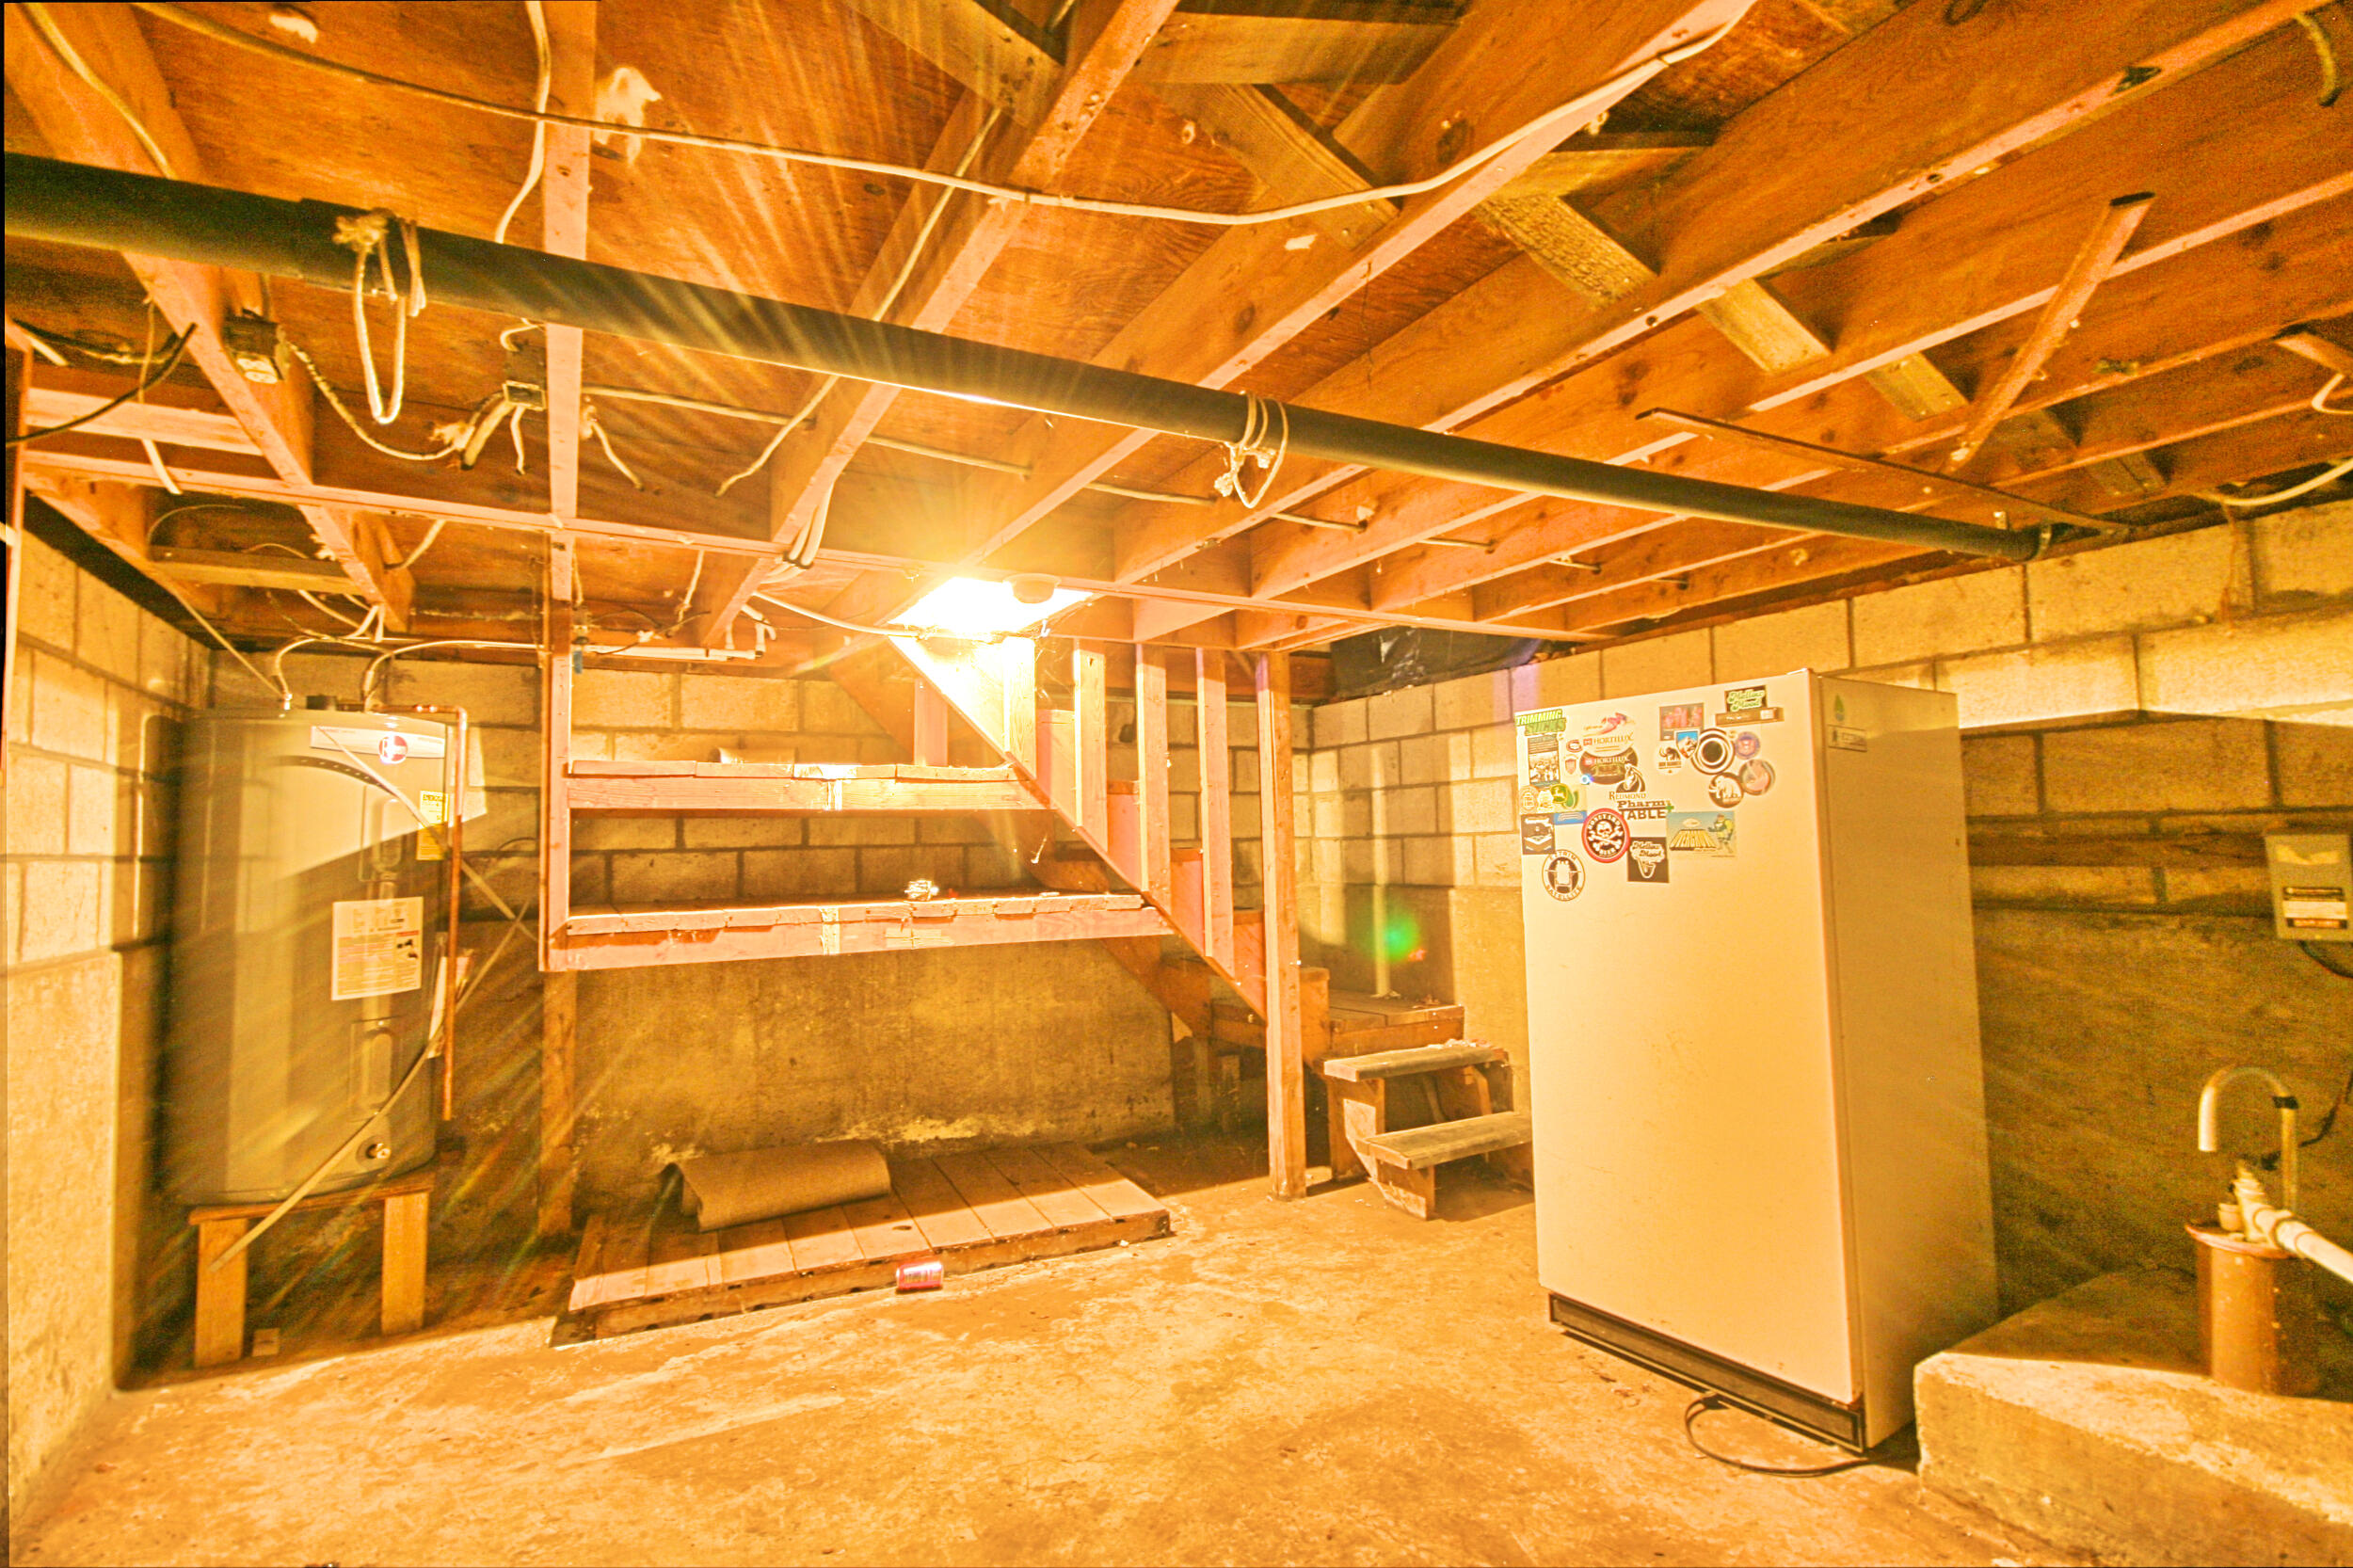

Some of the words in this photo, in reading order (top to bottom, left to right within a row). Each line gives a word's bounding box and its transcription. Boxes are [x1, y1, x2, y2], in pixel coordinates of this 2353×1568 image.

[1514, 710, 1562, 726] TRIMMING
[1526, 718, 1566, 735] SUCKS
[1617, 800, 1665, 808] Pharm
